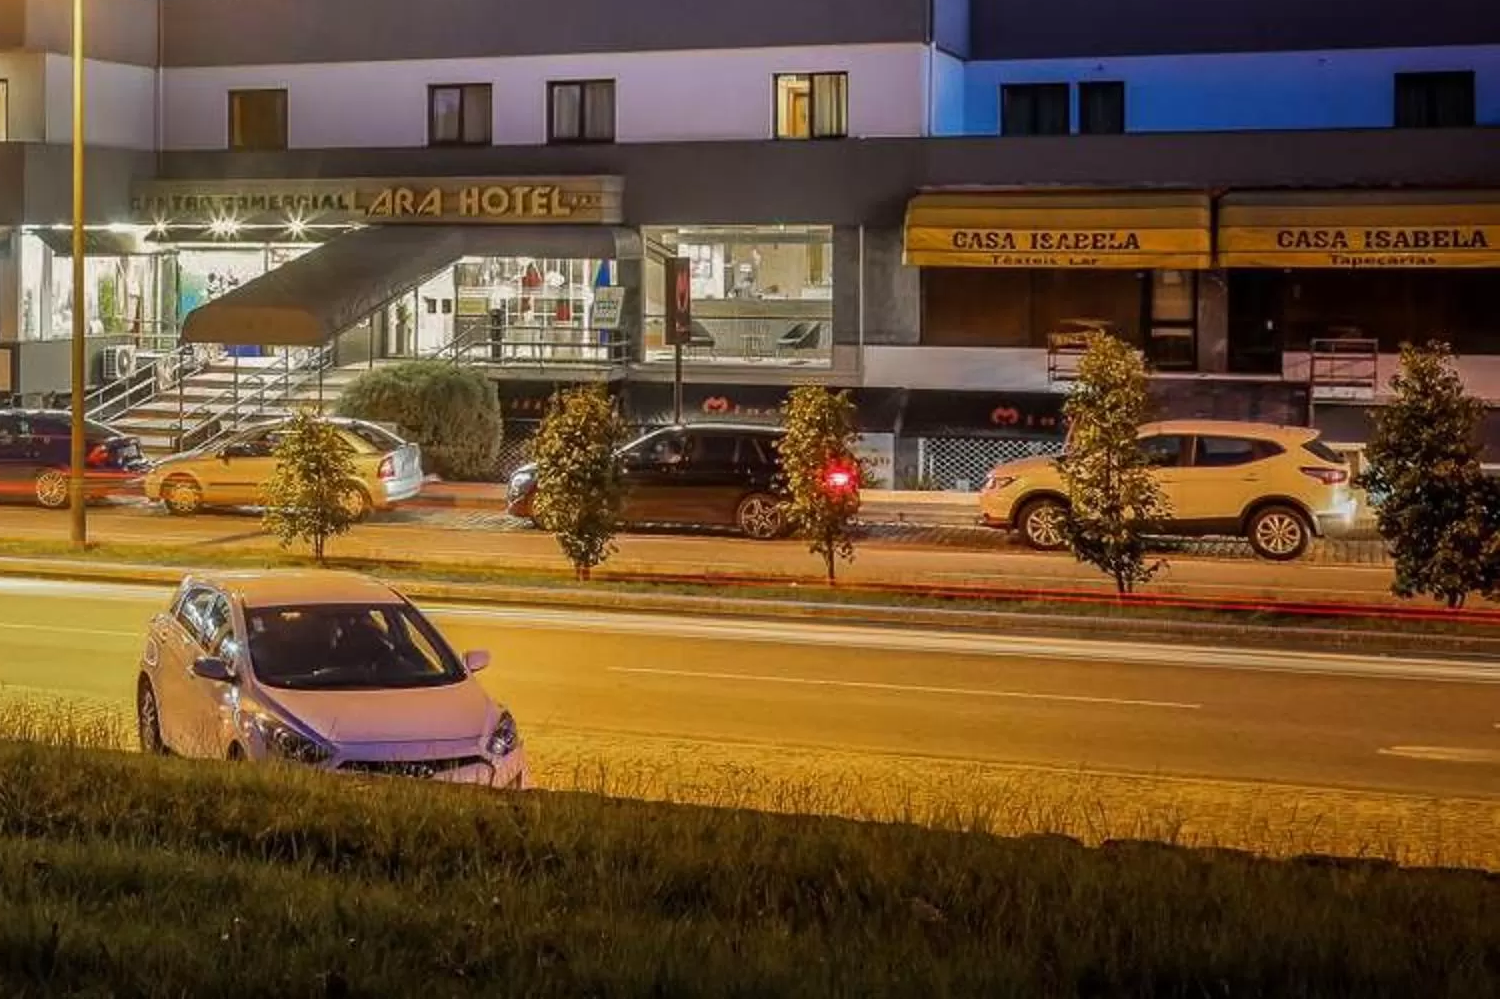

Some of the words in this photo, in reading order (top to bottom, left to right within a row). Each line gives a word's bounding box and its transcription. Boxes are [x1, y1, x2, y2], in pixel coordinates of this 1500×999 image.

[350, 185, 442, 218] LARA
[459, 185, 572, 217] HOTEL
[952, 231, 1017, 250] CASA
[1030, 232, 1141, 250] ISABELA
[1276, 230, 1348, 248] CASA
[1364, 230, 1488, 248] ISABELA
